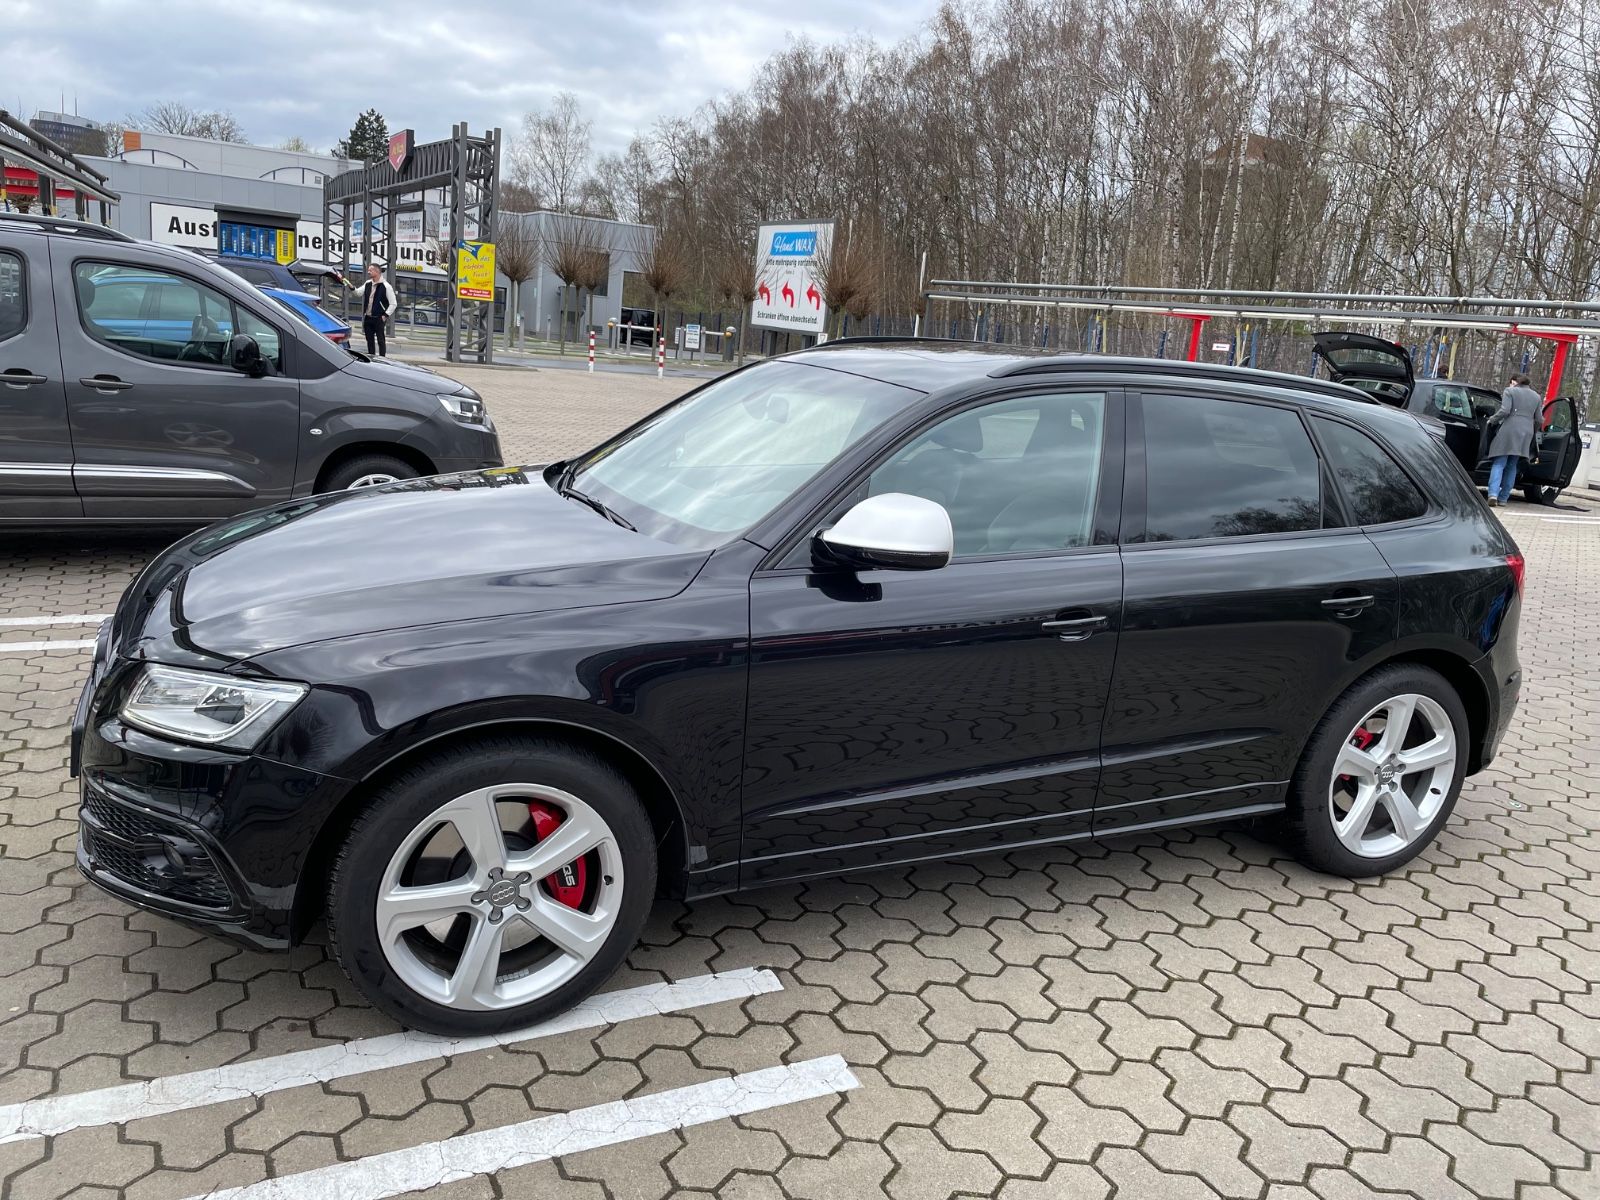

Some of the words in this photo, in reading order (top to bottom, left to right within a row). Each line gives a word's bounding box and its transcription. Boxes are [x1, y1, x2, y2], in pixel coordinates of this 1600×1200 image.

[773, 236, 795, 252] Hand
[794, 237, 814, 252] WAX
[757, 310, 777, 320] Schranken
